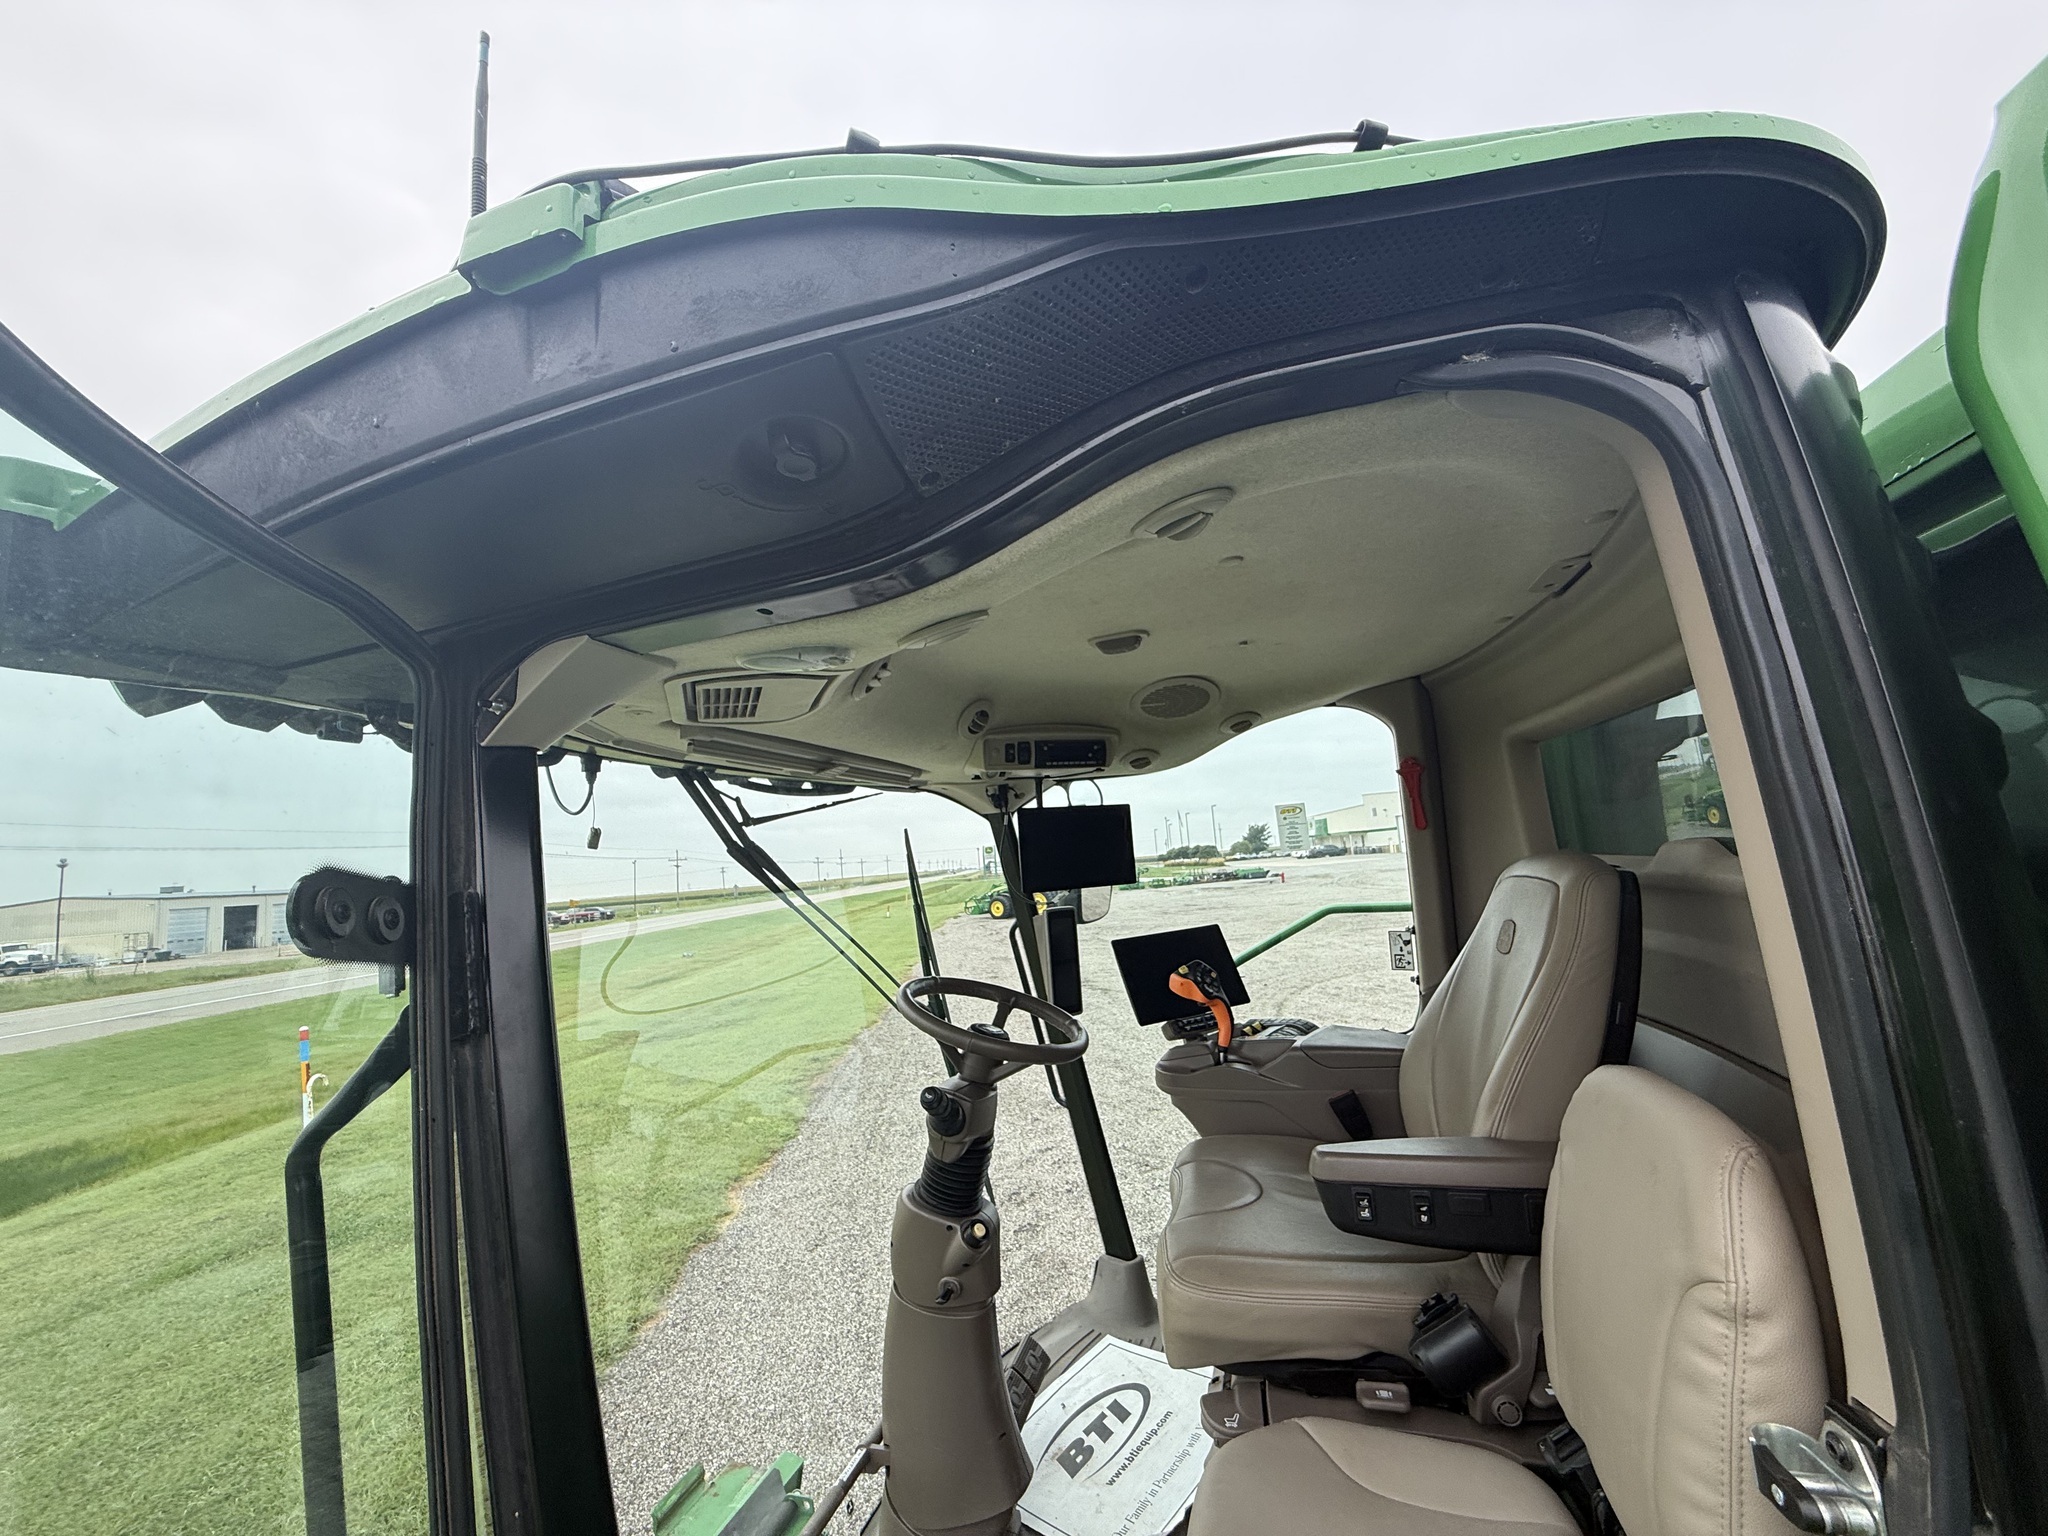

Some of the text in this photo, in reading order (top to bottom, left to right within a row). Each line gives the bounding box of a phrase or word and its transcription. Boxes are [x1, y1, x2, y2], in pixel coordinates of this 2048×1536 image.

[1056, 1398, 1132, 1479] BTI
[1105, 1410, 1174, 1486] www.btiequip.com
[1124, 1497, 1153, 1524] Family
[1145, 1488, 1159, 1498] in
[1152, 1448, 1192, 1489] Partnership
[1186, 1432, 1202, 1448] with
